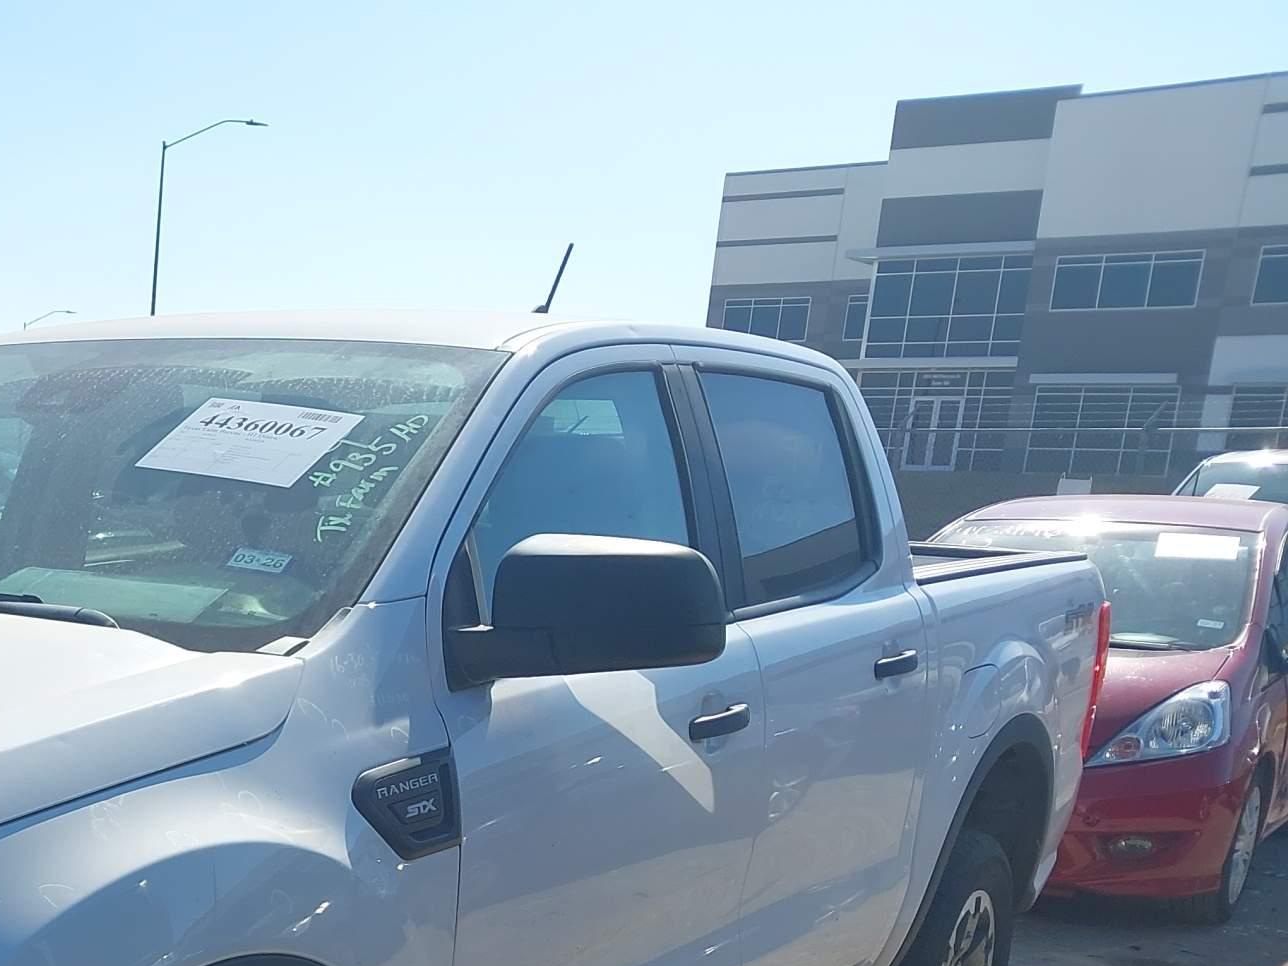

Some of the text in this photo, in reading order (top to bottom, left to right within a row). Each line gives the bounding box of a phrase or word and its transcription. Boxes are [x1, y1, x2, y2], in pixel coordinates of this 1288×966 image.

[199, 413, 327, 440] 44360067
[376, 773, 439, 800] RANGER
[406, 798, 437, 818] STX
